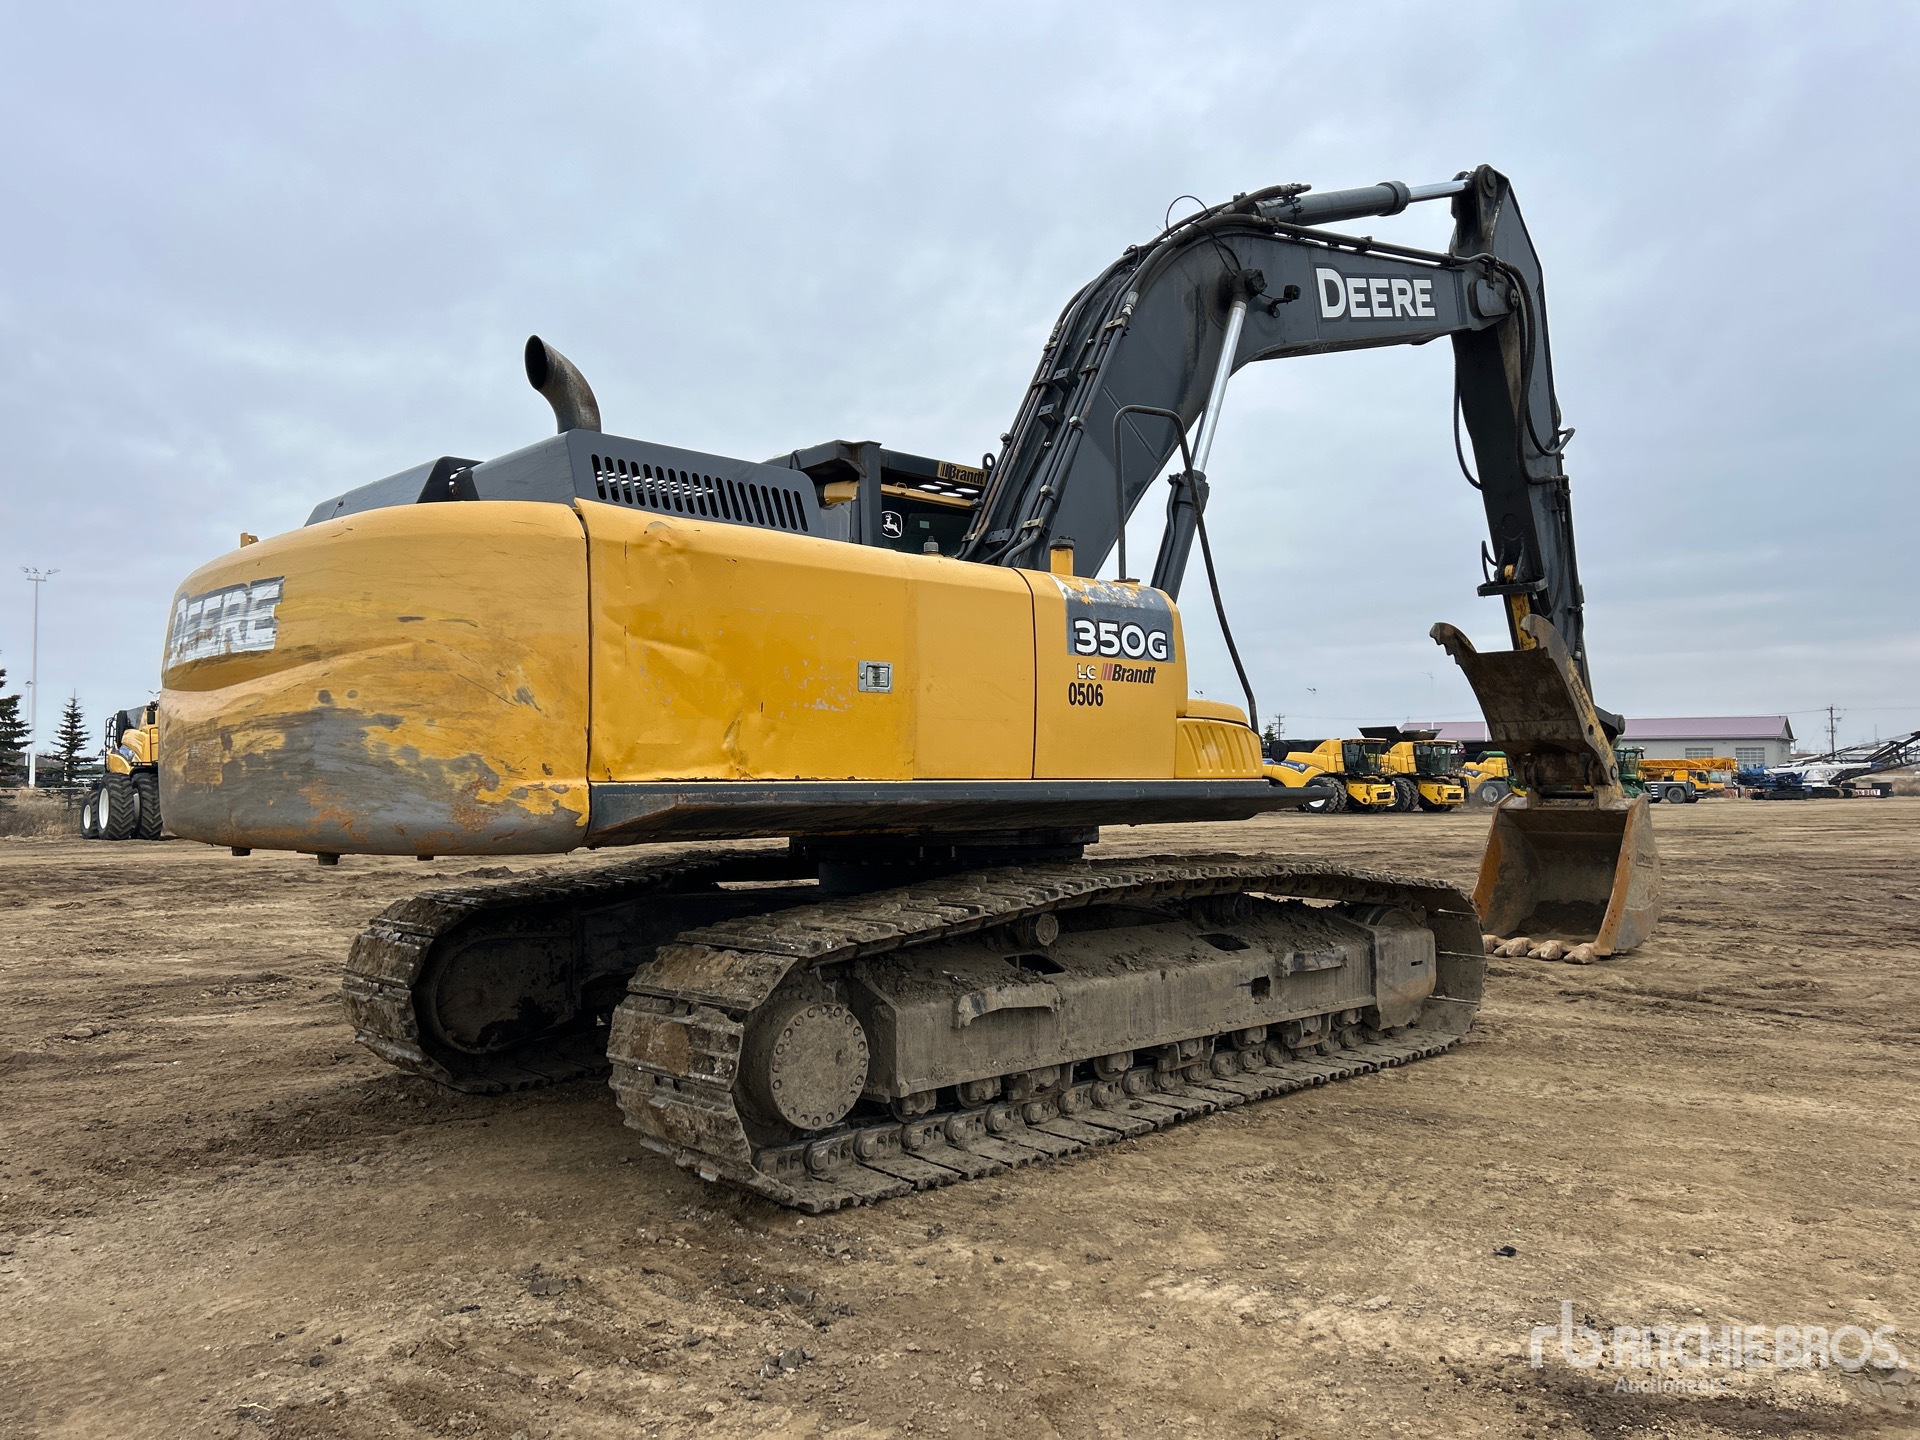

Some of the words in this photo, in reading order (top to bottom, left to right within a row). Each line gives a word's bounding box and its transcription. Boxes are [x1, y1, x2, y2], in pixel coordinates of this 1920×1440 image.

[1315, 267, 1436, 318] DEERE
[948, 464, 985, 484] Brandt
[1073, 618, 1169, 661] 350G
[1077, 663, 1096, 680] LC
[1111, 663, 1156, 684] Brandt
[1068, 682, 1104, 706] 0506
